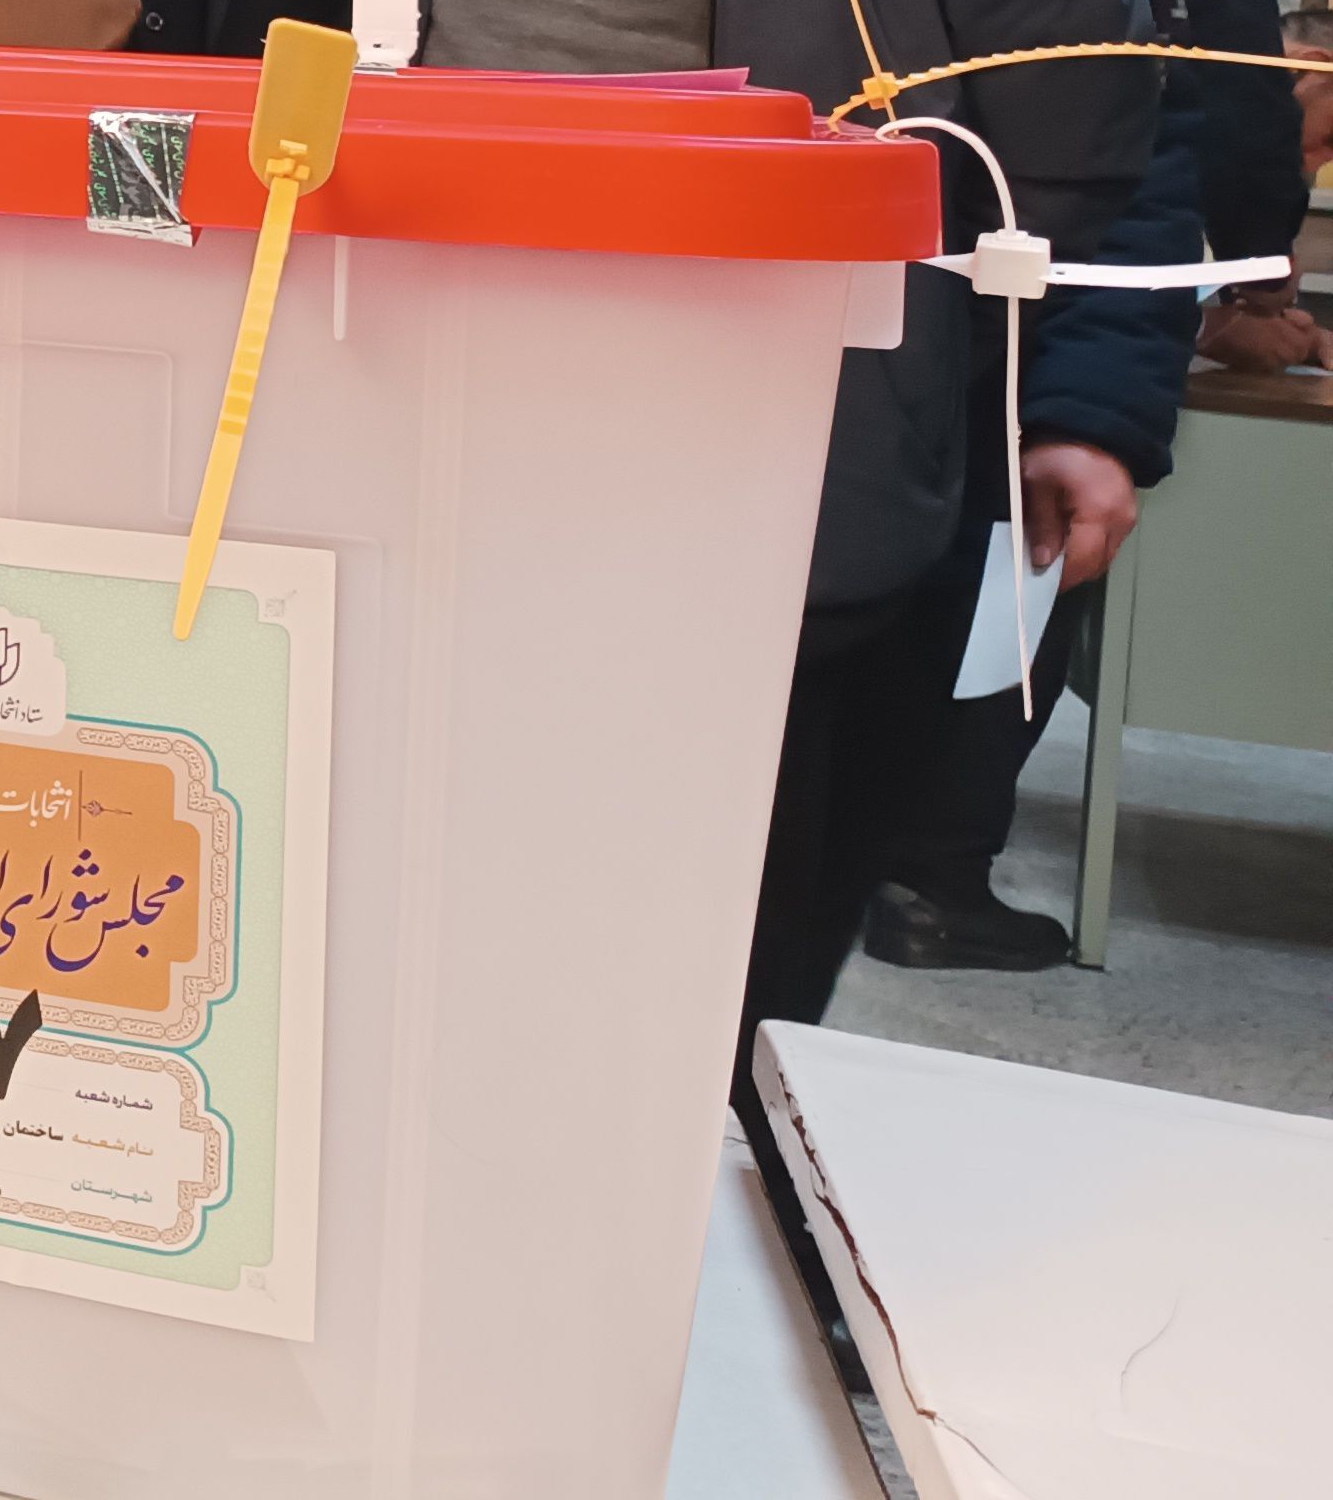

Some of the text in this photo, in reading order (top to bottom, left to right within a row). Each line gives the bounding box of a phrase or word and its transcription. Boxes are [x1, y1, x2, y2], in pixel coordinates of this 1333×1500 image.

[20, 704, 43, 724] ستاد
[45, 873, 185, 973] مجلس
[74, 1087, 154, 1111] شماره شعبه
[3, 1120, 64, 1141] ساختمان
[71, 1131, 126, 1152] شعبه
[126, 1141, 154, 1157] نام
[71, 1178, 154, 1204] شهرستان
